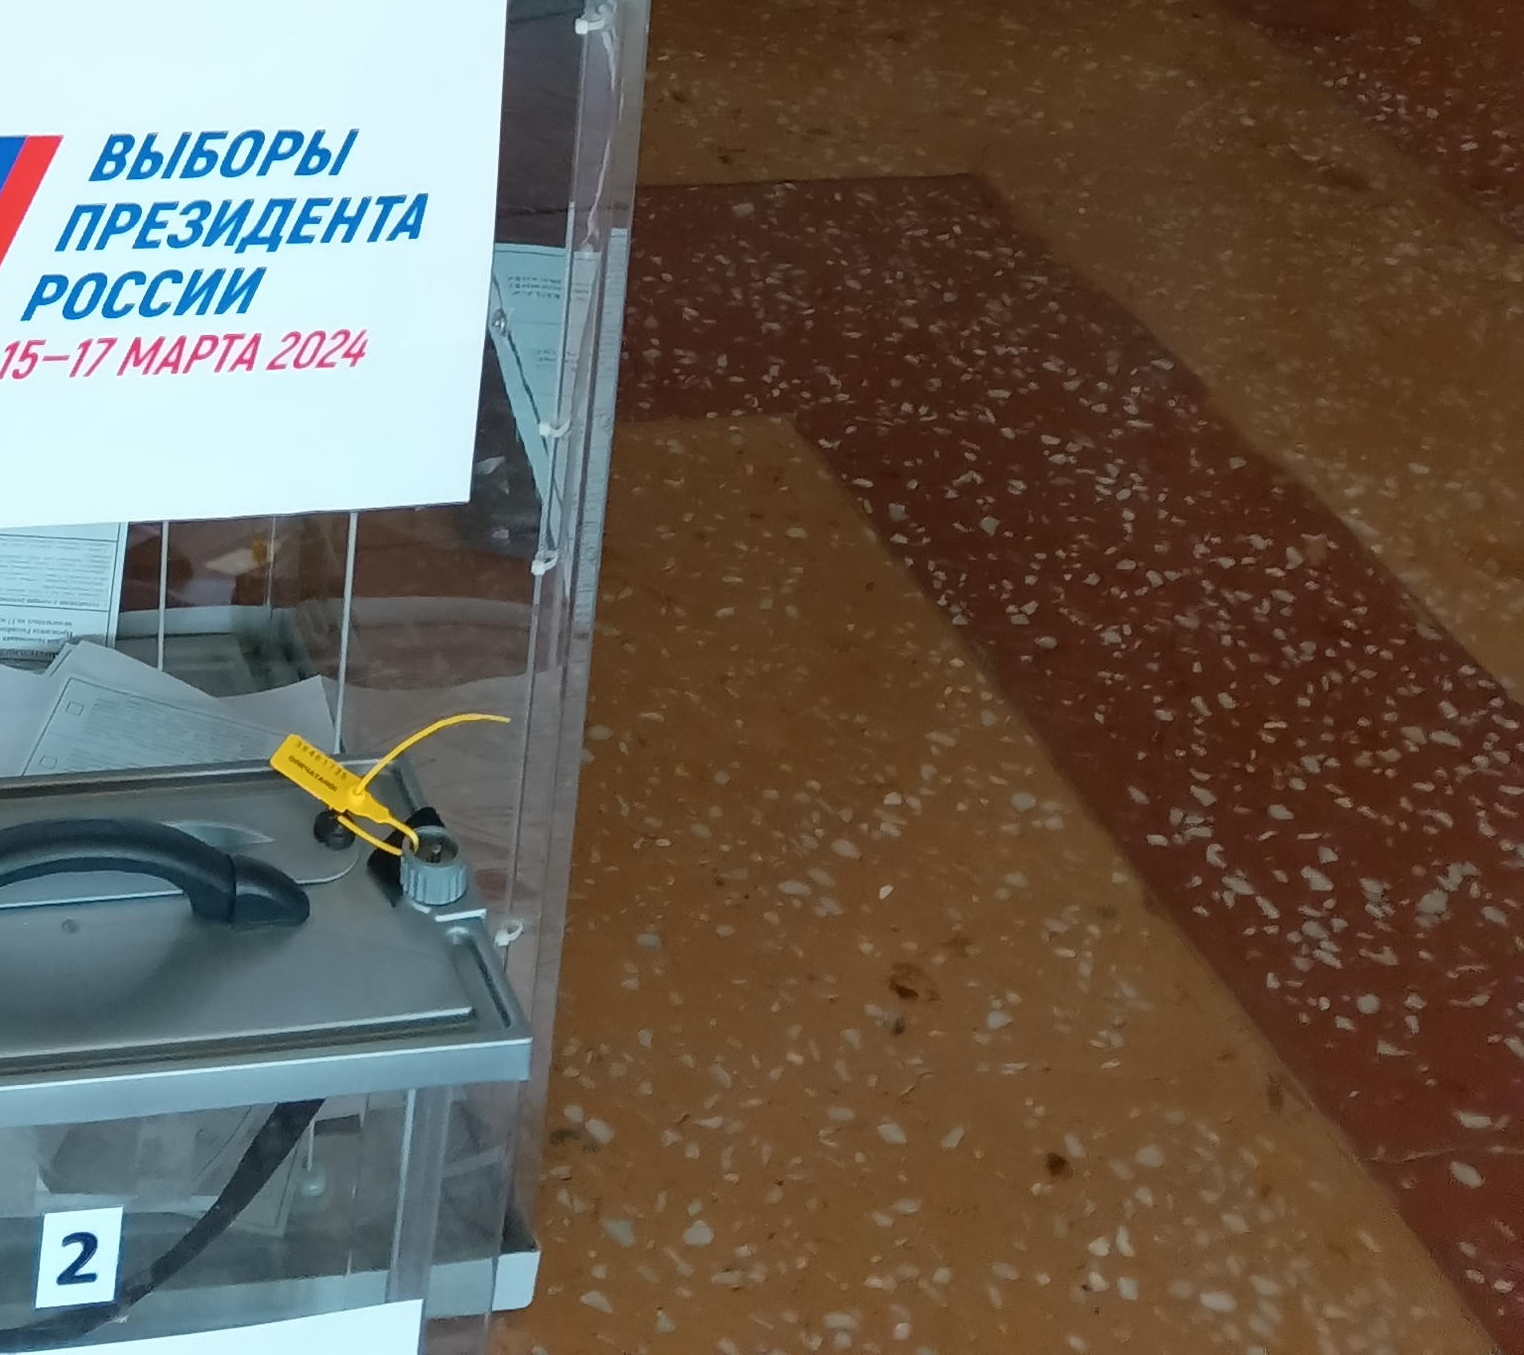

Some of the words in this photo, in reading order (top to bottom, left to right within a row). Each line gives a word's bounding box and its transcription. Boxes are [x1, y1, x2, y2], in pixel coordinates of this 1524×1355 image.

[88, 128, 360, 182] ВЫБОРЫ
[54, 192, 429, 254] ПРЕЗИДЕНТА
[20, 267, 267, 322] РОССИИ
[116, 333, 262, 377] МАРТА
[266, 328, 369, 372] 2024
[57, 1231, 98, 1286] 2
